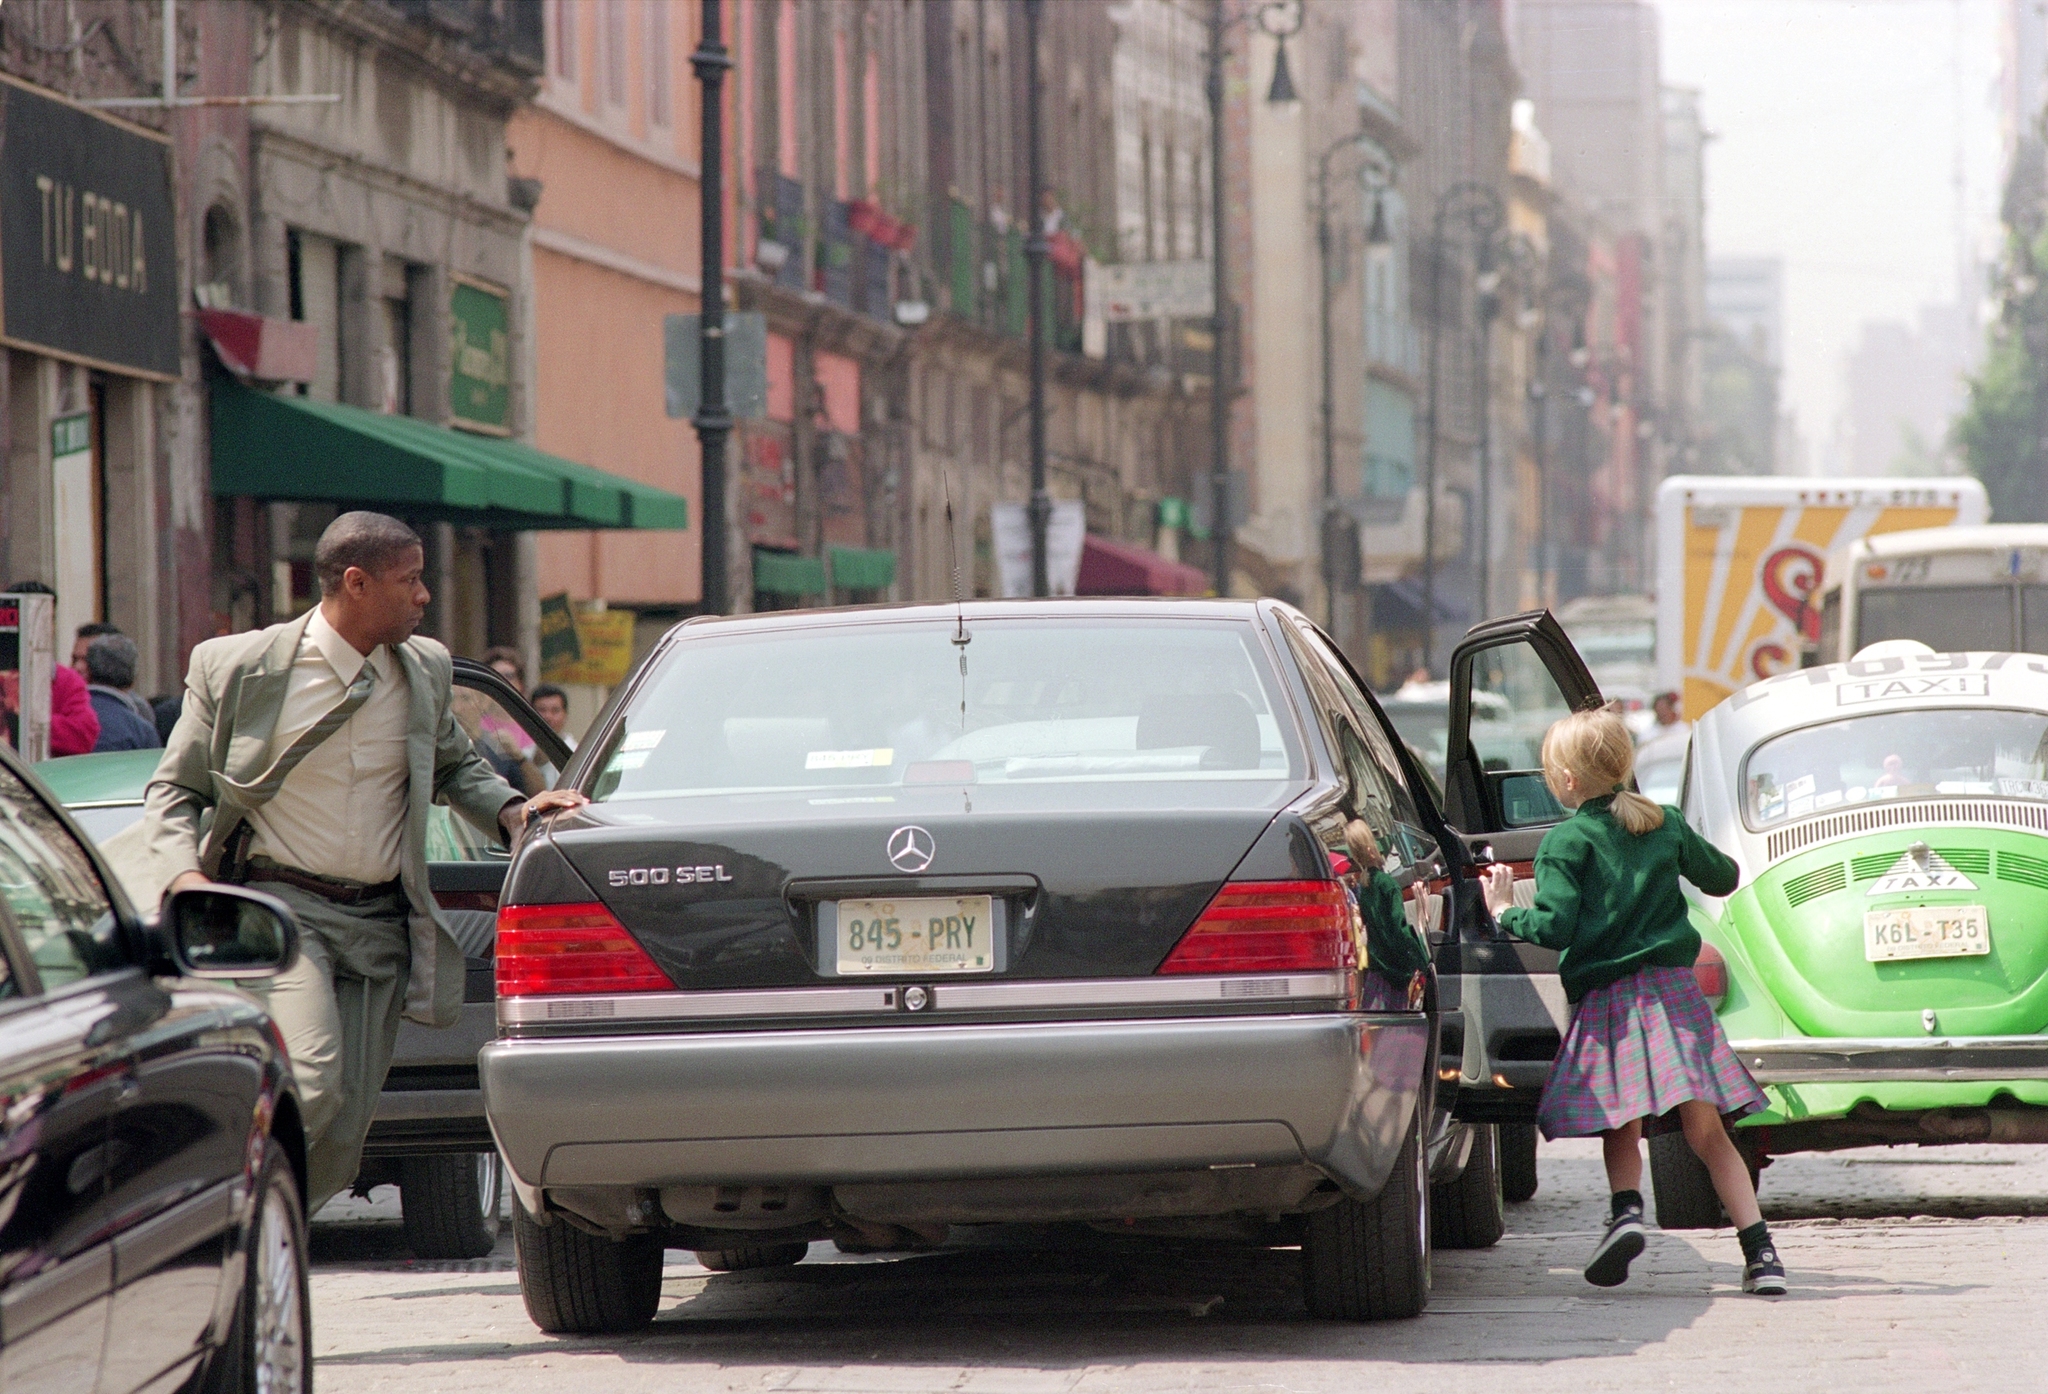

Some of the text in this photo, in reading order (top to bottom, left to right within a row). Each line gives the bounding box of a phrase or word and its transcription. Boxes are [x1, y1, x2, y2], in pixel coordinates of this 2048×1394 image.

[36, 175, 148, 294] TU BODA
[1854, 677, 1967, 699] TAXI
[608, 864, 733, 887] 500 SEL
[1885, 875, 1958, 889] TAXI
[875, 954, 921, 964] DISTRITO
